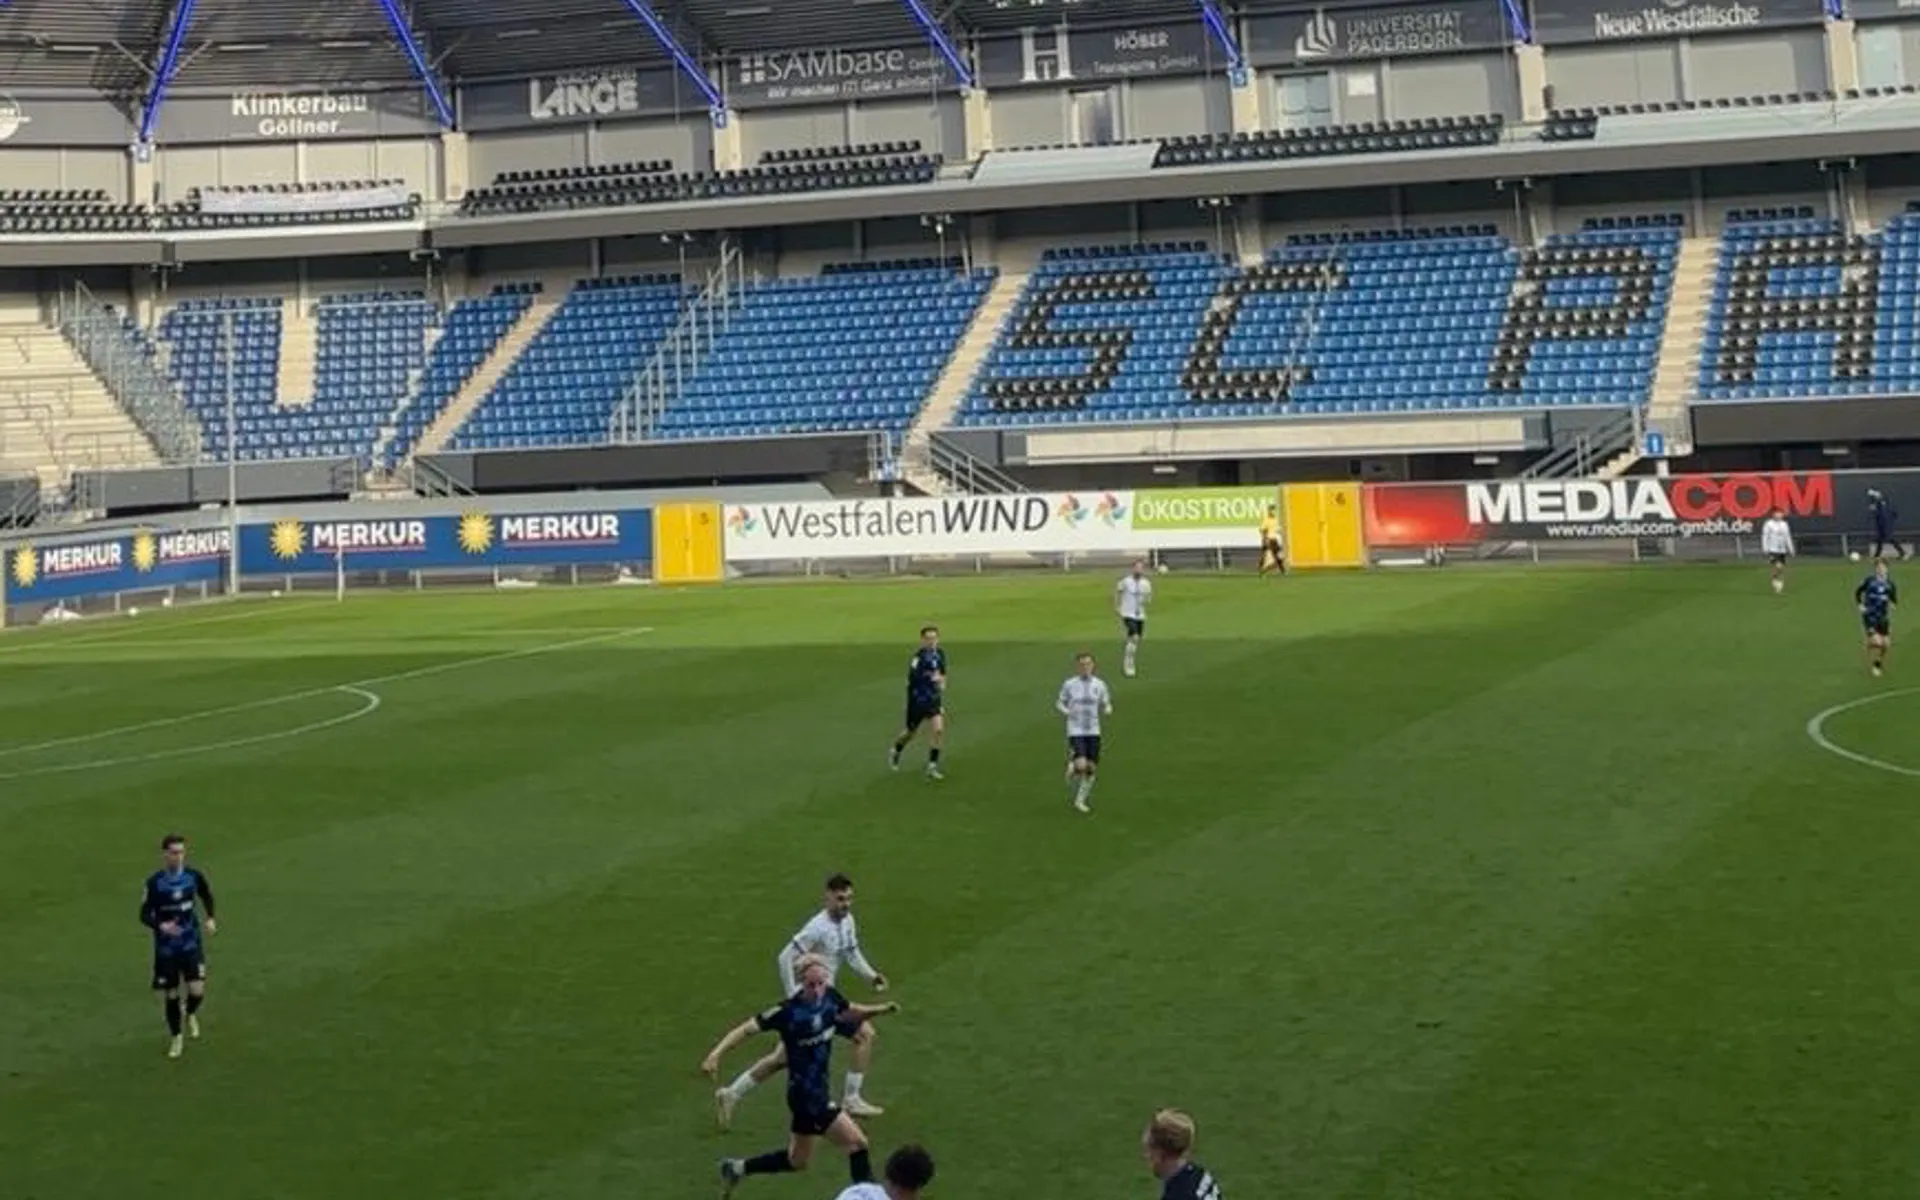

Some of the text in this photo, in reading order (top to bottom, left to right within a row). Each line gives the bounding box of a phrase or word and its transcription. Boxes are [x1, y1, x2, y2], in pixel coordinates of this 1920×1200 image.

[1347, 10, 1462, 36] UNIVERSITÄT
[1593, 1, 1760, 40] Neue Westfälische
[1348, 30, 1463, 55] PADERBORN
[766, 49, 905, 82] SAMbase
[231, 92, 368, 115] Klinkerbau
[530, 78, 638, 118] LANGE
[258, 118, 340, 136] Göllner
[1465, 472, 1833, 525] MEDIACOM
[312, 521, 426, 548] MERKUR
[501, 514, 619, 541] MERKUR
[1546, 518, 1753, 538] www.mediacom-gmbh.de
[43, 542, 122, 573] MERKUR
[159, 530, 230, 558] MERKUR
